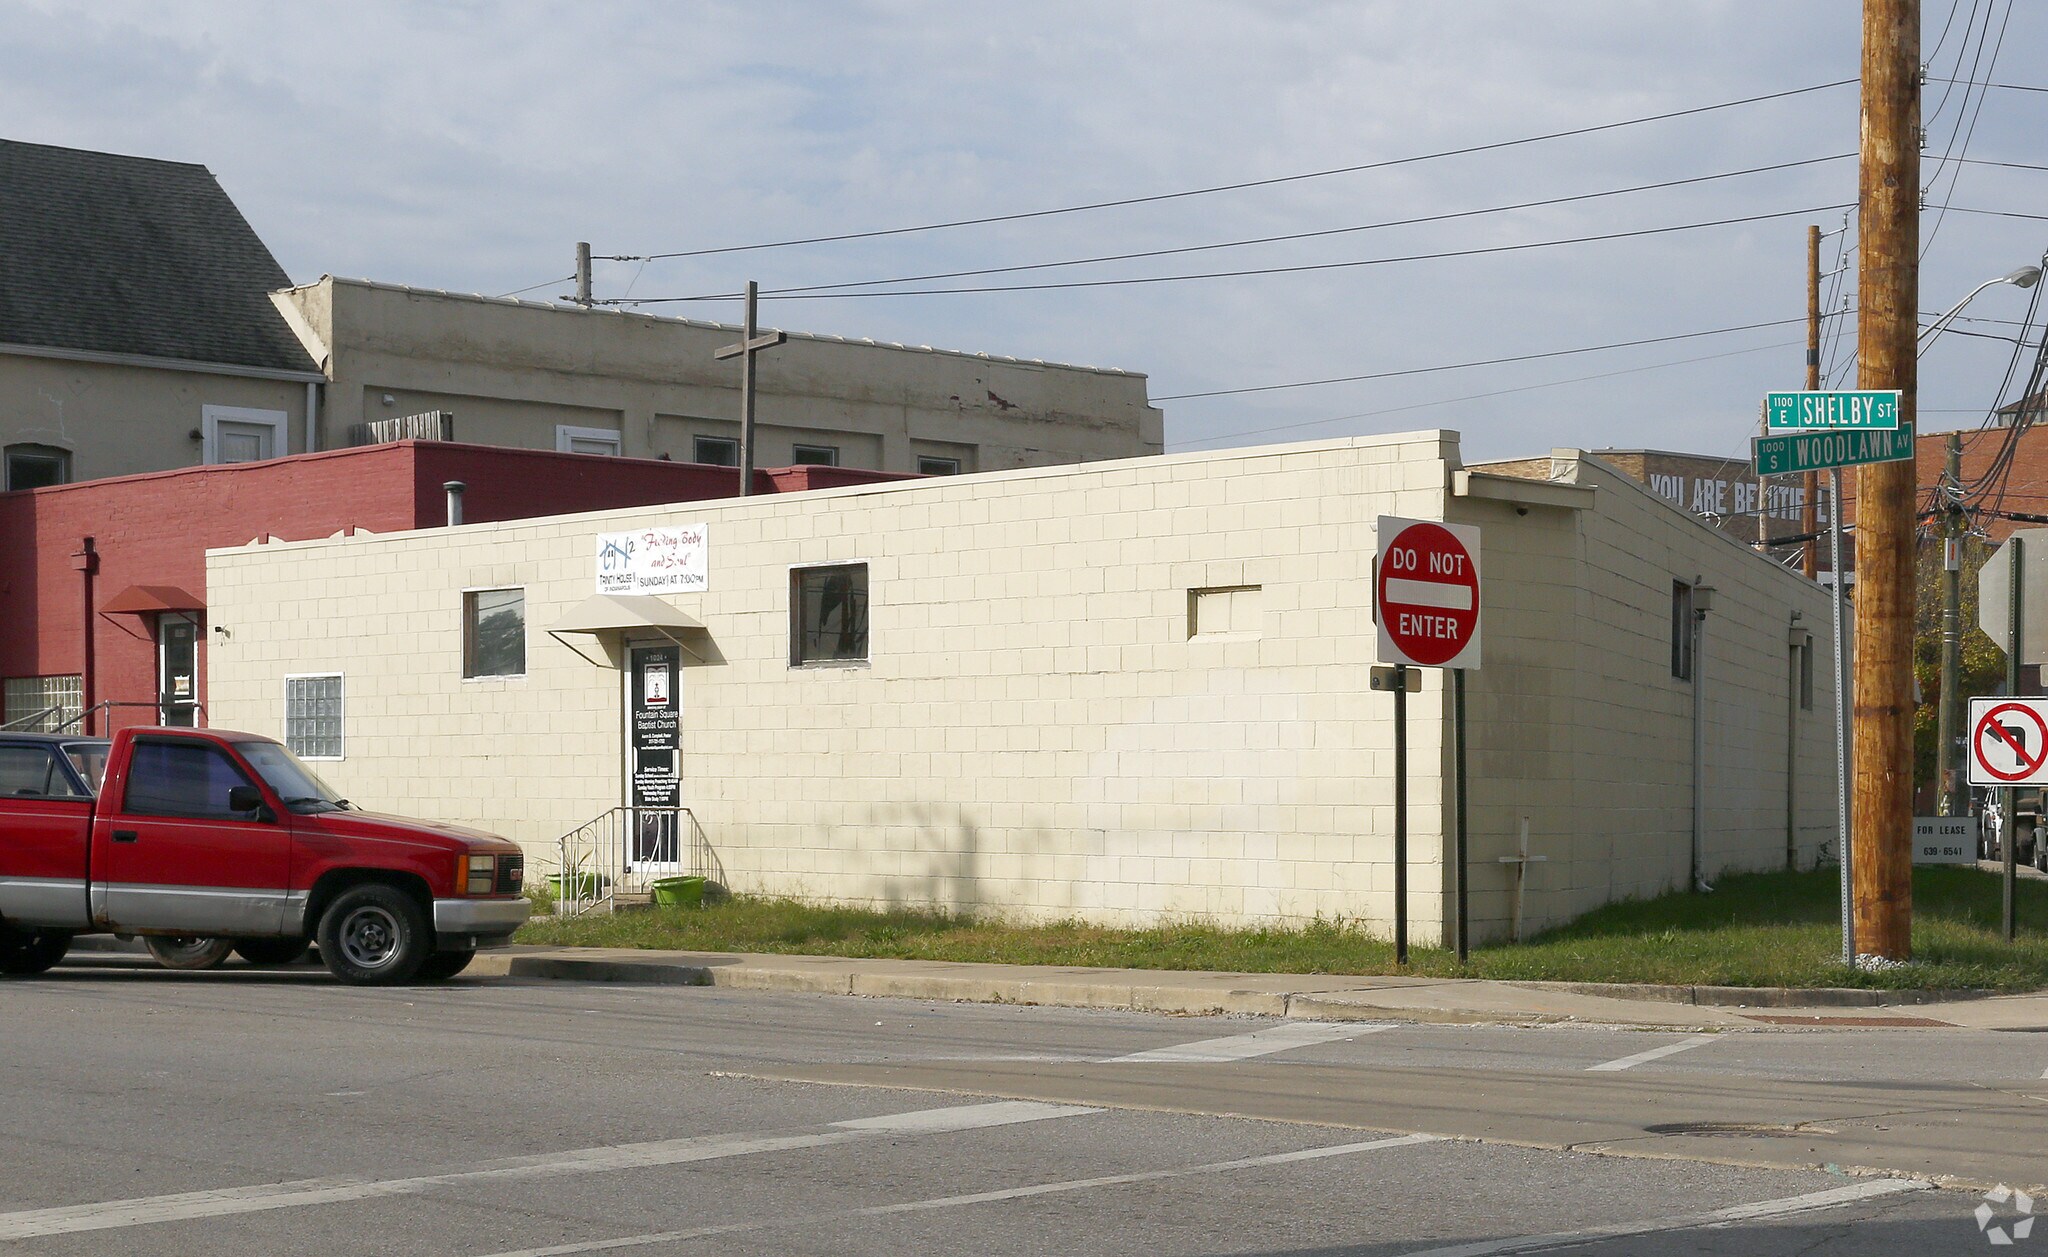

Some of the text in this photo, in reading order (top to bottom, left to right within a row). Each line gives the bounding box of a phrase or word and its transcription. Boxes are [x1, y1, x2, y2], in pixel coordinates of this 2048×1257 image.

[1774, 397, 1793, 407] 1100
[1780, 410, 1787, 424] E
[1803, 397, 1892, 425] SHELBY ST
[1762, 441, 1785, 453] 1000
[1796, 430, 1909, 467] WOODLAWN AV
[1770, 455, 1778, 470] S
[1650, 474, 1827, 523] YOU ARE BEUTIFL
[681, 531, 702, 547] Body
[651, 554, 665, 567] and
[1393, 547, 1465, 576] DO NOT
[616, 573, 632, 583] HOUSE
[670, 575, 677, 584] AT
[1400, 613, 1458, 639] ENTER
[635, 710, 679, 719] Fountain Square
[637, 720, 677, 730] Baptist Church
[1917, 826, 1966, 835] FOR LEASE
